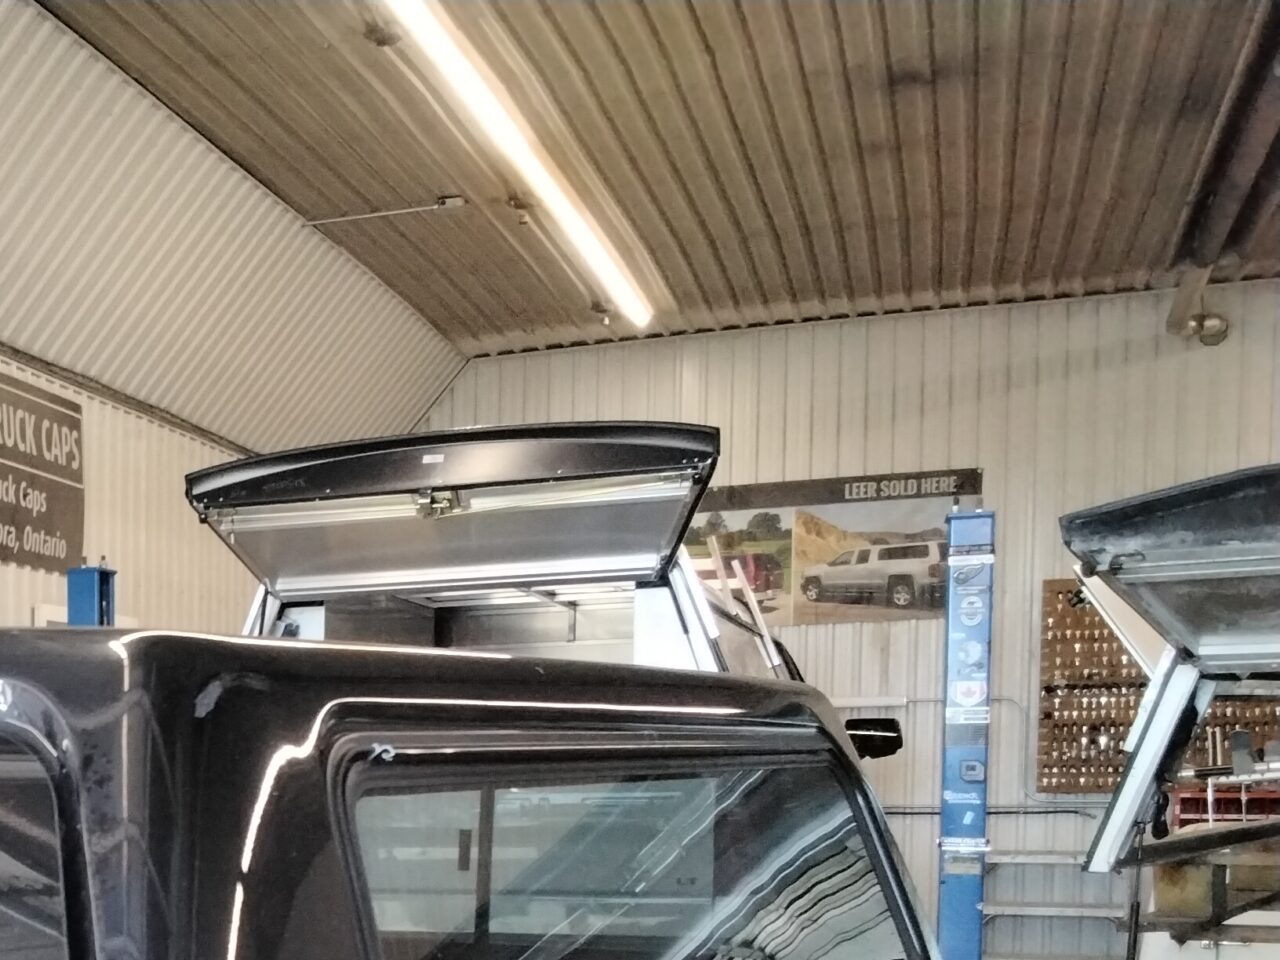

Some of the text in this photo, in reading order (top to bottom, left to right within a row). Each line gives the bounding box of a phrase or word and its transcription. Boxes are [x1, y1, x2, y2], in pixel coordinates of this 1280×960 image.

[42, 418, 80, 470] CAPS
[20, 481, 47, 517] Caps
[844, 476, 958, 499] LEER SOLD HERE
[23, 525, 67, 559] Ontario
